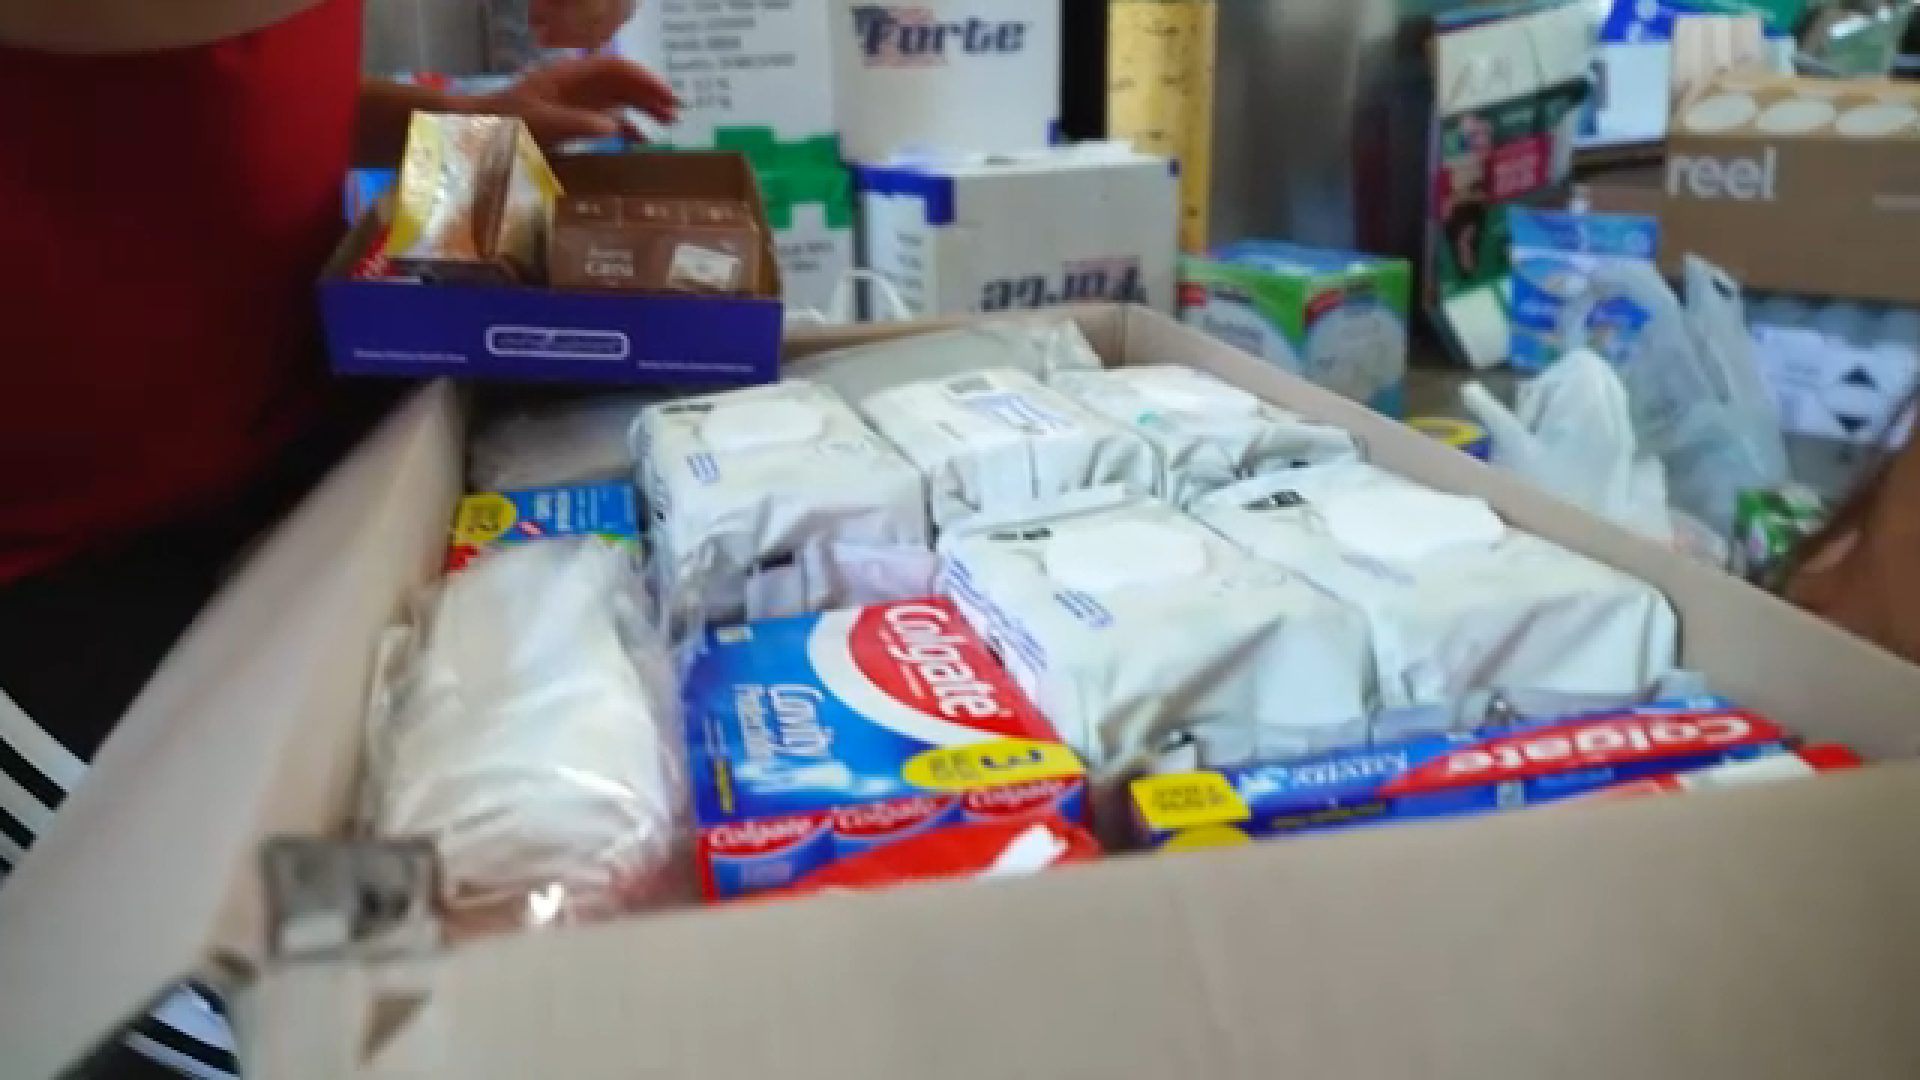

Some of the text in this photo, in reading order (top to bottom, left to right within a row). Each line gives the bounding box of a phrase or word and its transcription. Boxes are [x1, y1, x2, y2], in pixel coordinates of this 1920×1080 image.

[853, 6, 1025, 55] Forte
[1666, 147, 1776, 200] reel
[884, 605, 1001, 718] Colgate
[1447, 715, 1752, 775] Colgate
[708, 817, 812, 849] Colgate
